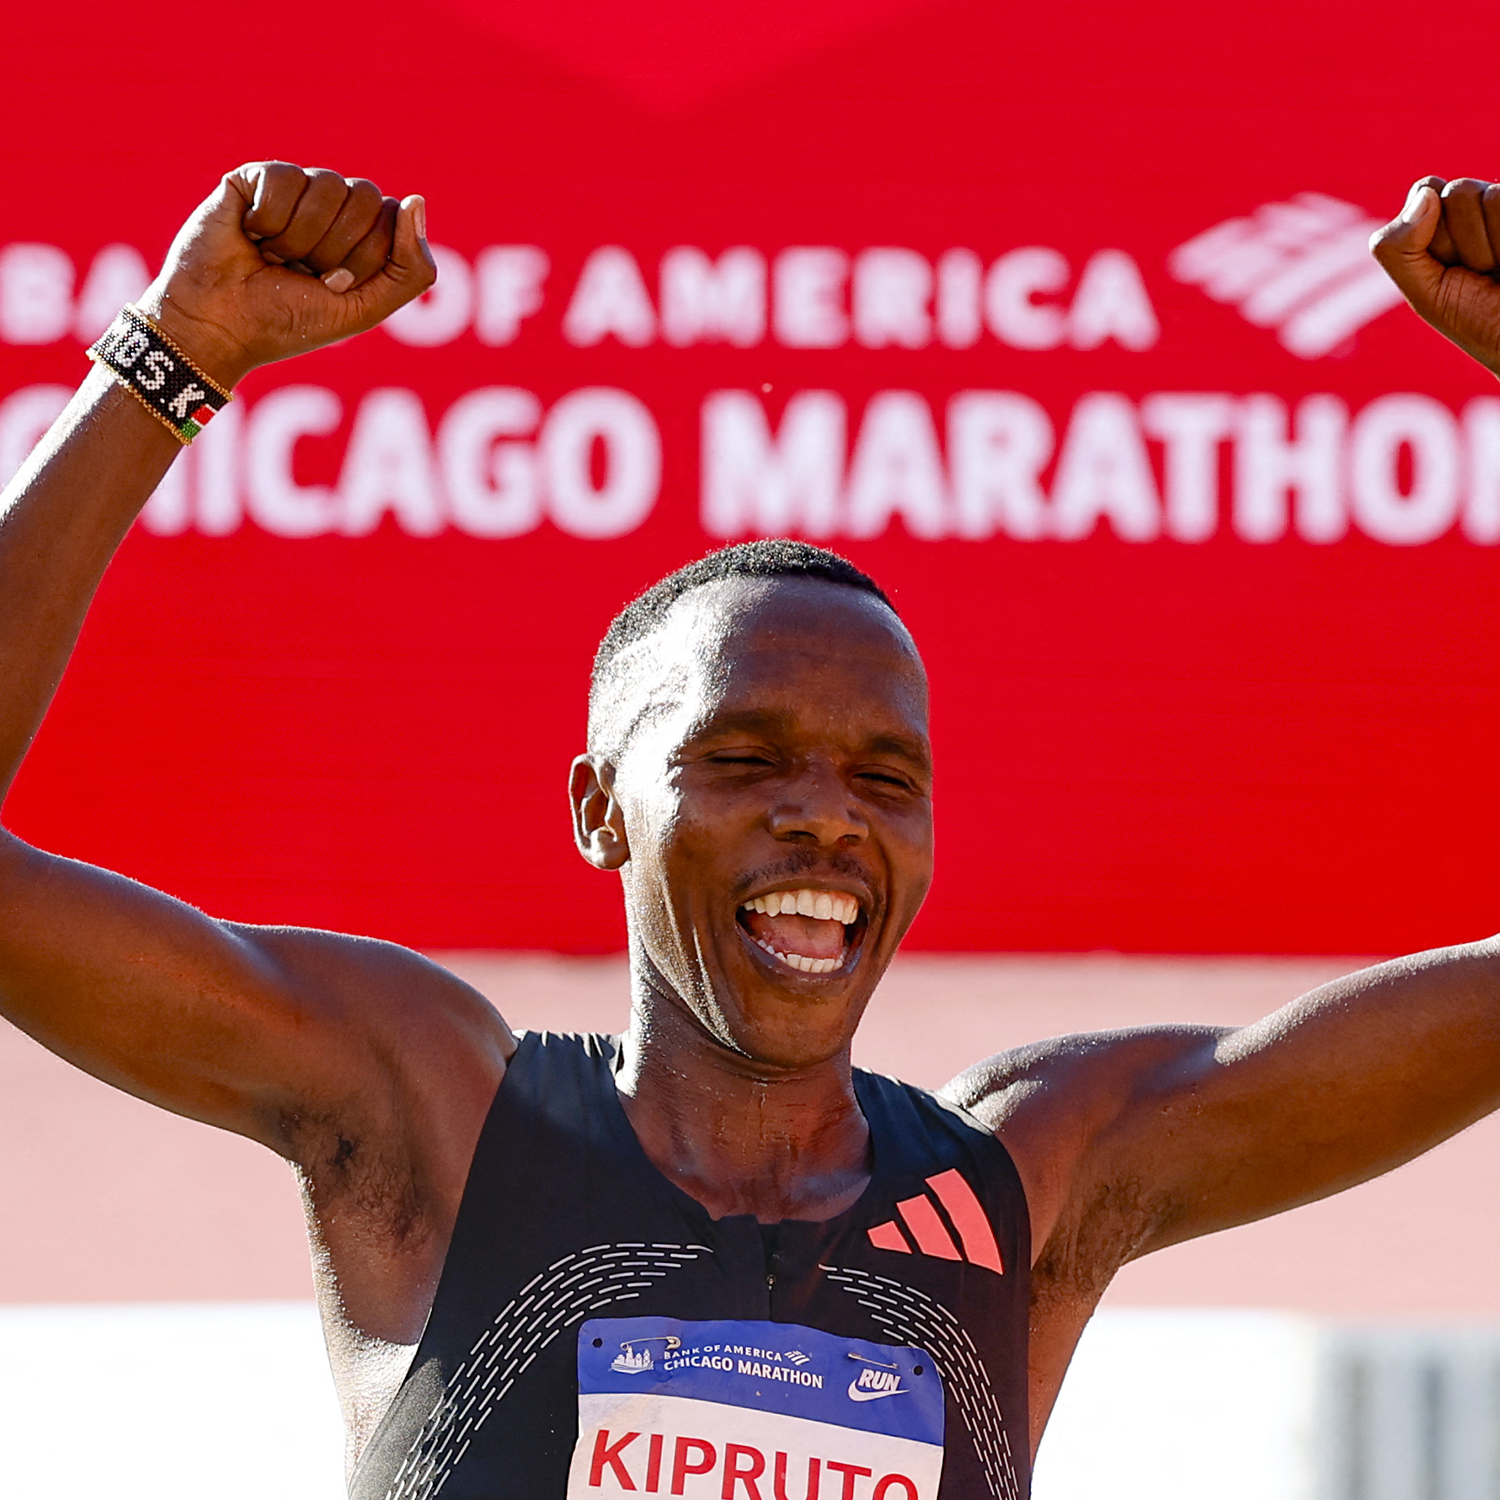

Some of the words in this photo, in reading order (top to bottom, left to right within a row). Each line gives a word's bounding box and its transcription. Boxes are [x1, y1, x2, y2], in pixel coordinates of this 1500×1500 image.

[562, 245, 1159, 350] AMERICA
[663, 1347, 700, 1360] BANK
[703, 1344, 721, 1353] OF
[723, 1344, 782, 1362] AMERICA
[663, 1355, 734, 1372] CHICAGO
[737, 1359, 824, 1389] MARATHON
[857, 1369, 902, 1392] RUN
